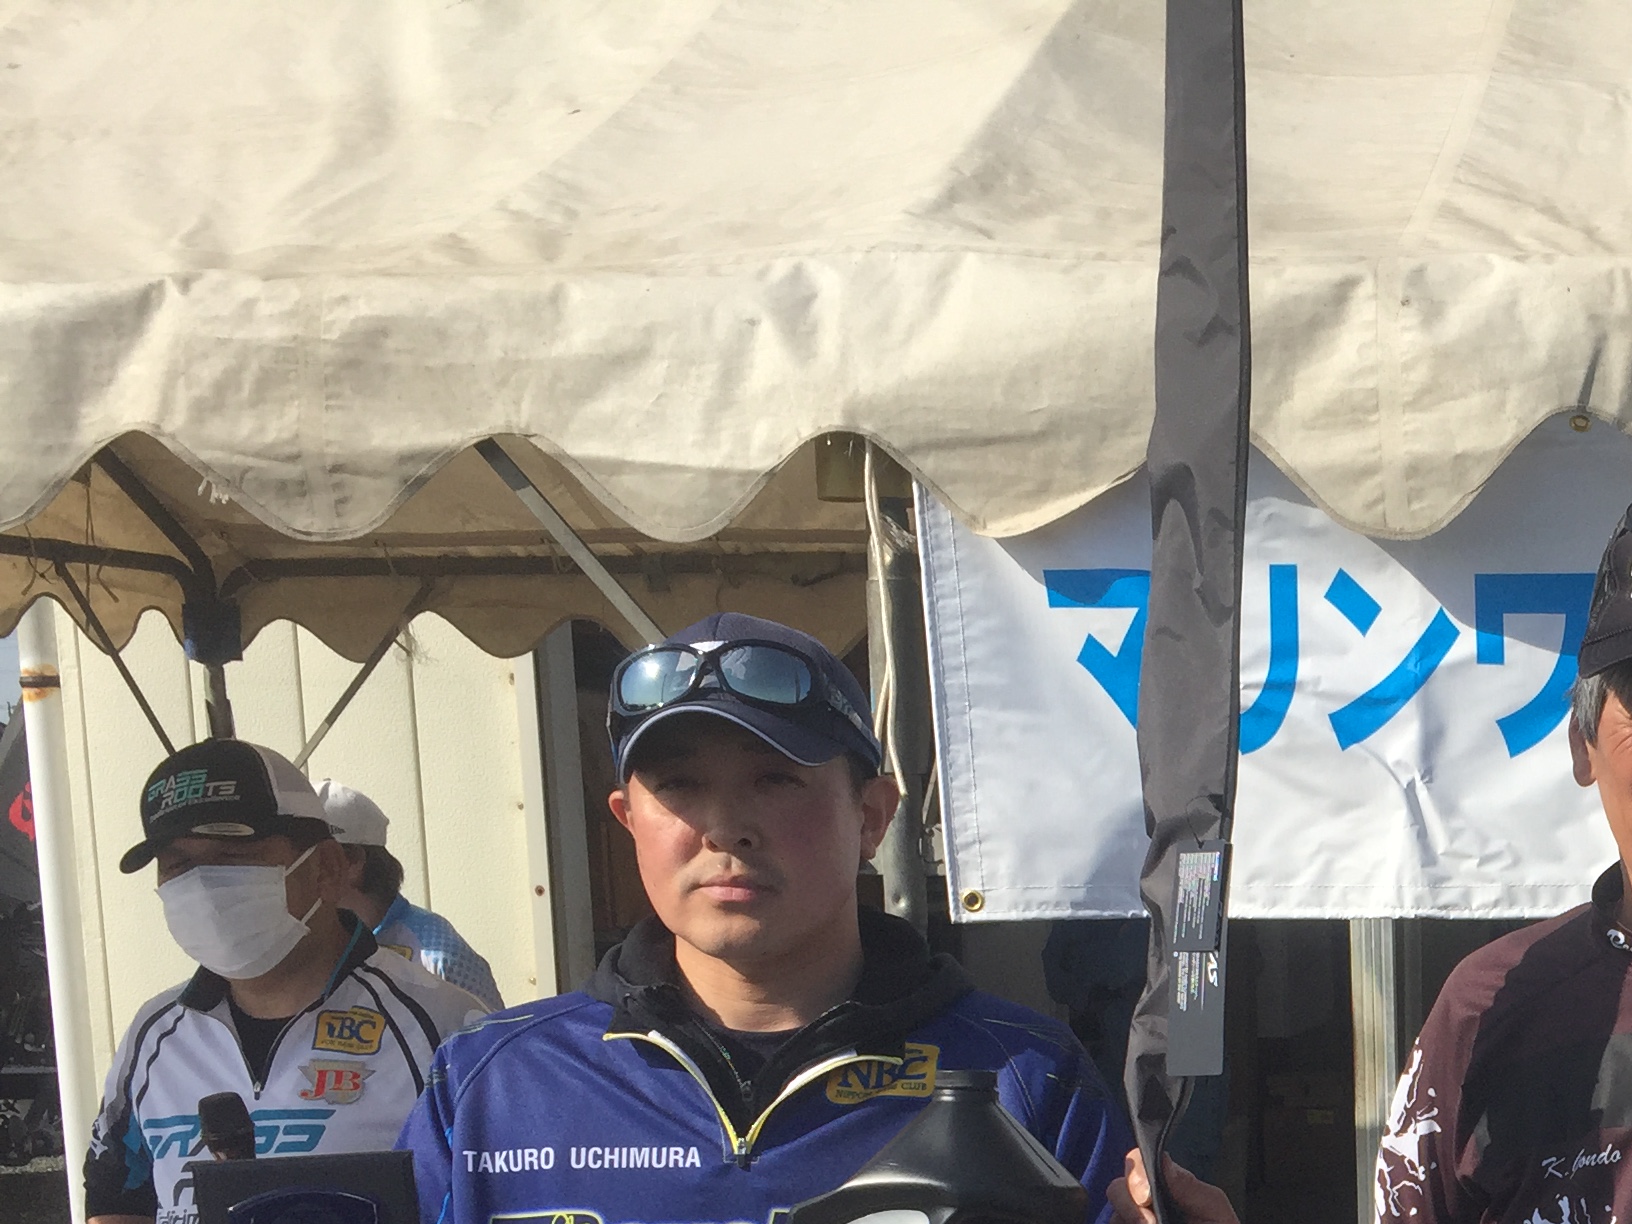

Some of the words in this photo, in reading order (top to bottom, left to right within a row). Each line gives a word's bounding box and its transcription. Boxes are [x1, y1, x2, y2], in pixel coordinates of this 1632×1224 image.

[301, 1069, 361, 1099] JB
[143, 1108, 337, 1160] GRSS
[462, 1146, 556, 1174] TAKURO
[570, 1146, 702, 1170] UCHIMURA
